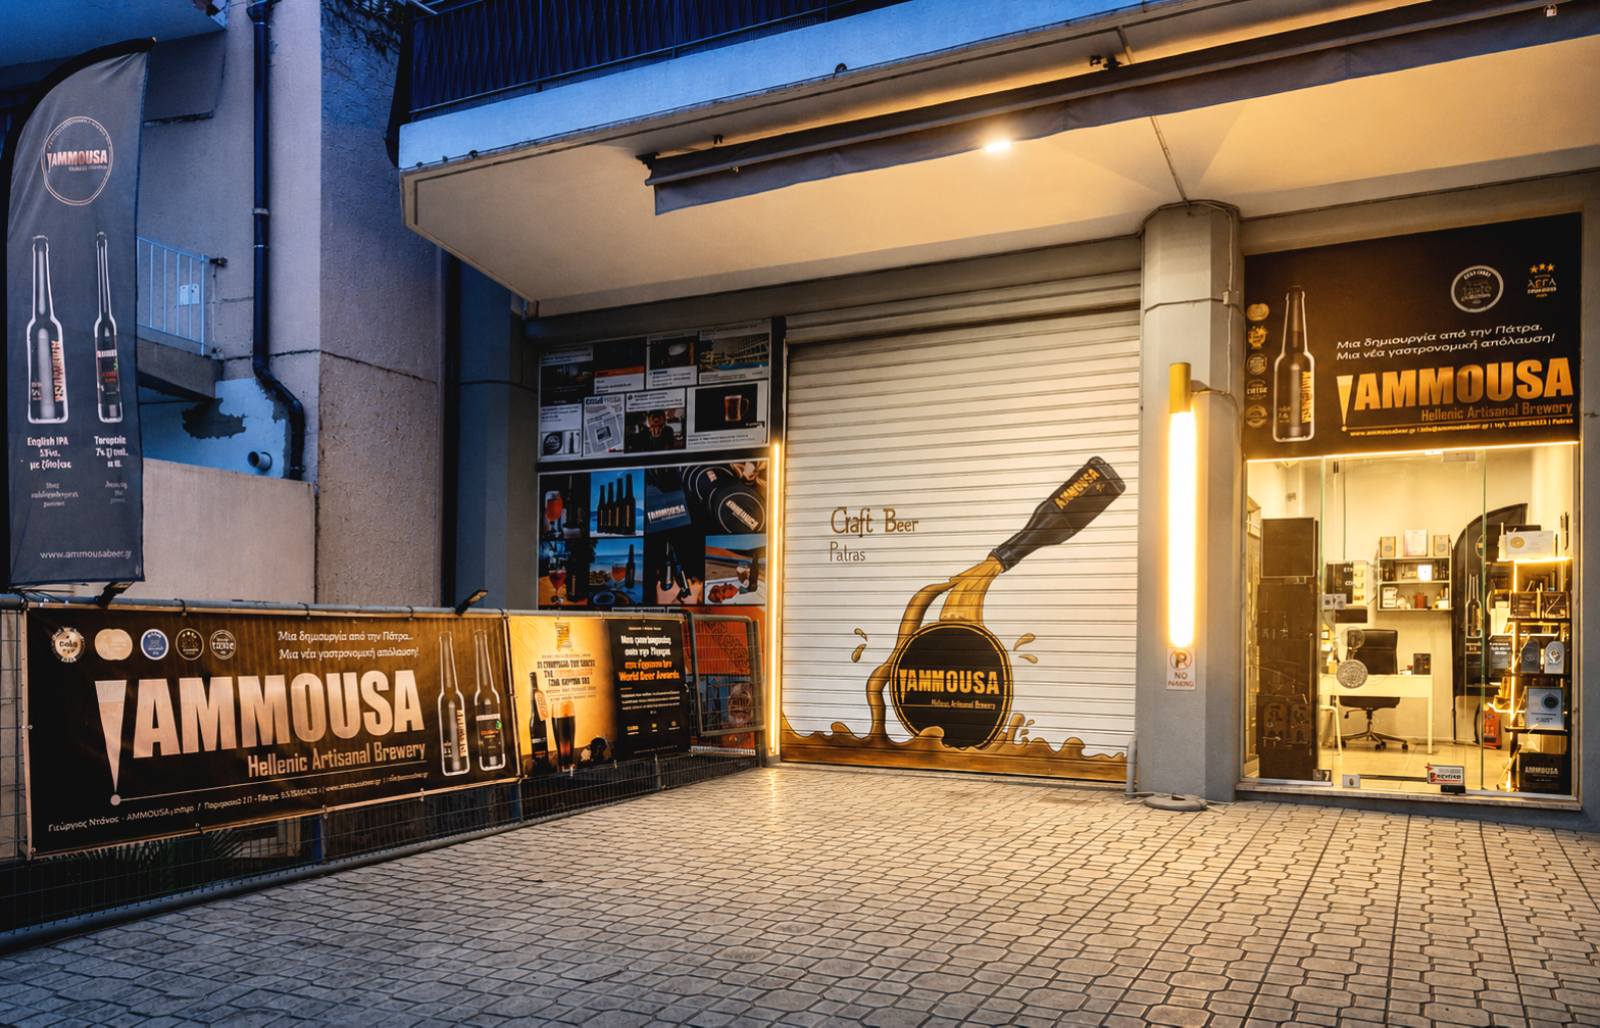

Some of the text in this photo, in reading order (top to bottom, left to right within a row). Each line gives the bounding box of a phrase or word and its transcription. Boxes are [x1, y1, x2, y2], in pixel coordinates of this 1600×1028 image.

[1336, 333, 1556, 361] Μια νέα γαστρονομική απόλαυση!
[1337, 341, 1360, 351] Μια
[1364, 333, 1437, 347] δημιουργία
[1440, 331, 1466, 342] από
[1470, 329, 1492, 340] την
[1421, 401, 1574, 422] Hellenic Artisanal Brewery
[831, 506, 919, 537] Craft Beer
[829, 541, 866, 562] Patras
[247, 741, 426, 777] Hellenic Artisanal Brewery
